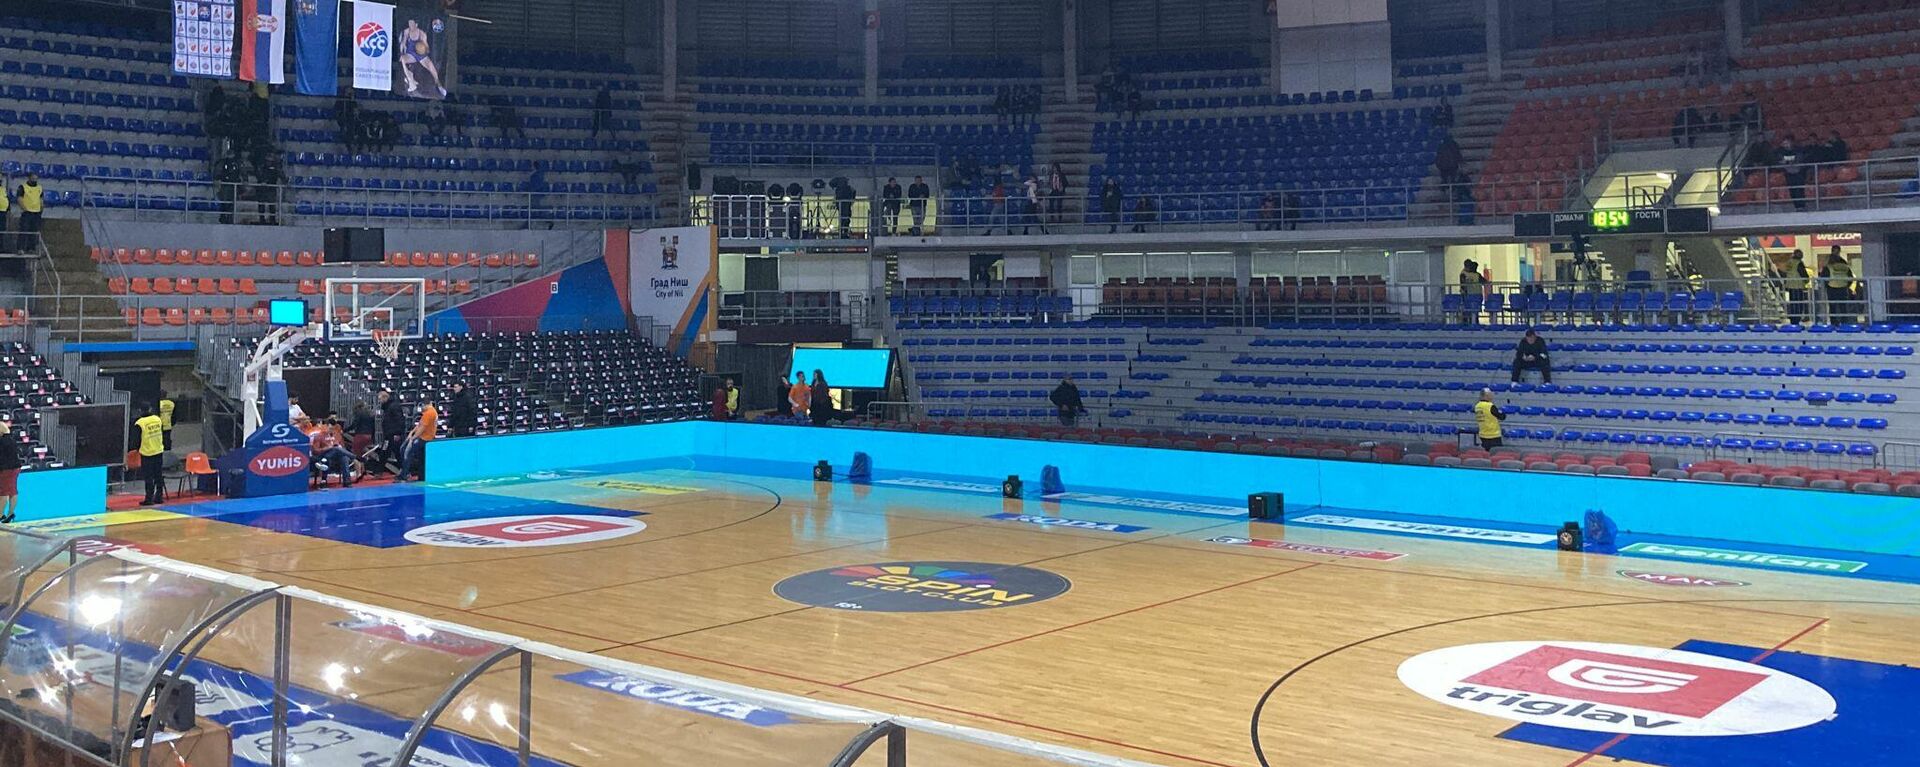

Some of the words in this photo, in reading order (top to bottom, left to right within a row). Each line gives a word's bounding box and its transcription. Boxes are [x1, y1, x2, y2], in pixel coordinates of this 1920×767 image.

[1635, 211, 1661, 219] ГОСТИ
[650, 277, 669, 290] Град
[670, 276, 689, 287] Ниш
[655, 290, 667, 300] City
[667, 289, 674, 298] of
[1446, 686, 1682, 729] triglav
